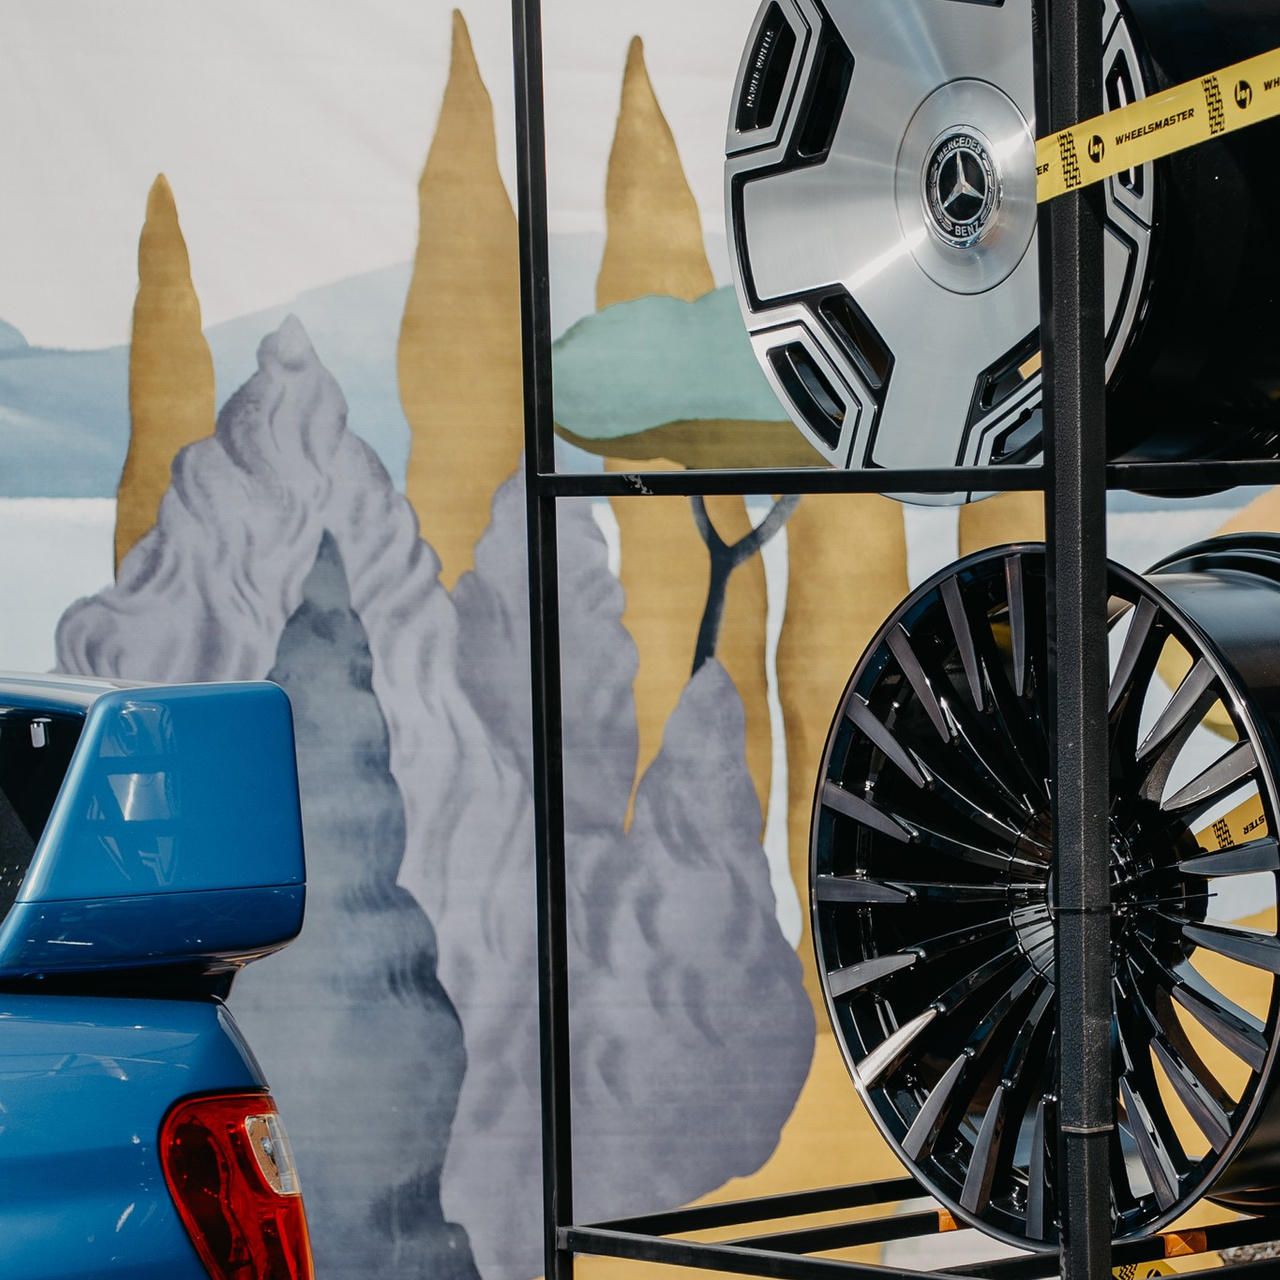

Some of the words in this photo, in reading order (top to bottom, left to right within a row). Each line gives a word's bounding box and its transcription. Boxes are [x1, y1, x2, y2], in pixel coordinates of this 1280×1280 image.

[1114, 107, 1195, 147] WHEELSMASTER
[936, 136, 983, 163] MERCEDES
[955, 221, 981, 237] BENZ
